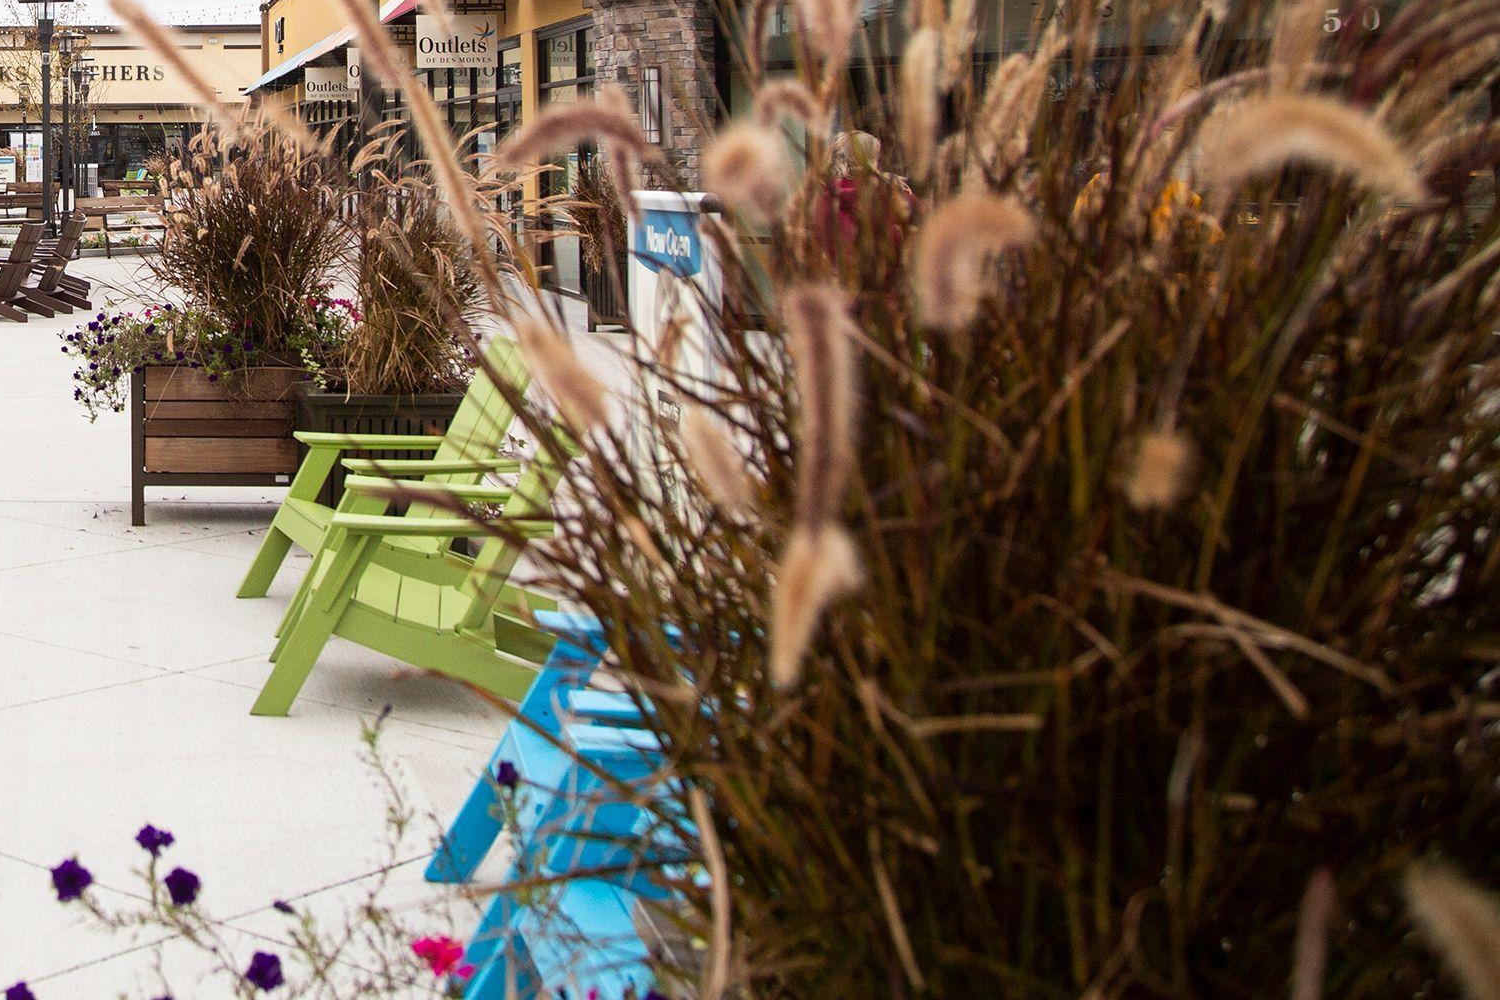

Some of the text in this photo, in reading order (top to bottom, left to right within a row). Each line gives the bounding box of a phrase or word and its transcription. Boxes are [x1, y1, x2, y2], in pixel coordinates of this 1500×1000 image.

[418, 35, 488, 54] Outlets
[306, 81, 348, 92] Outlets
[646, 225, 691, 263] Now Open
